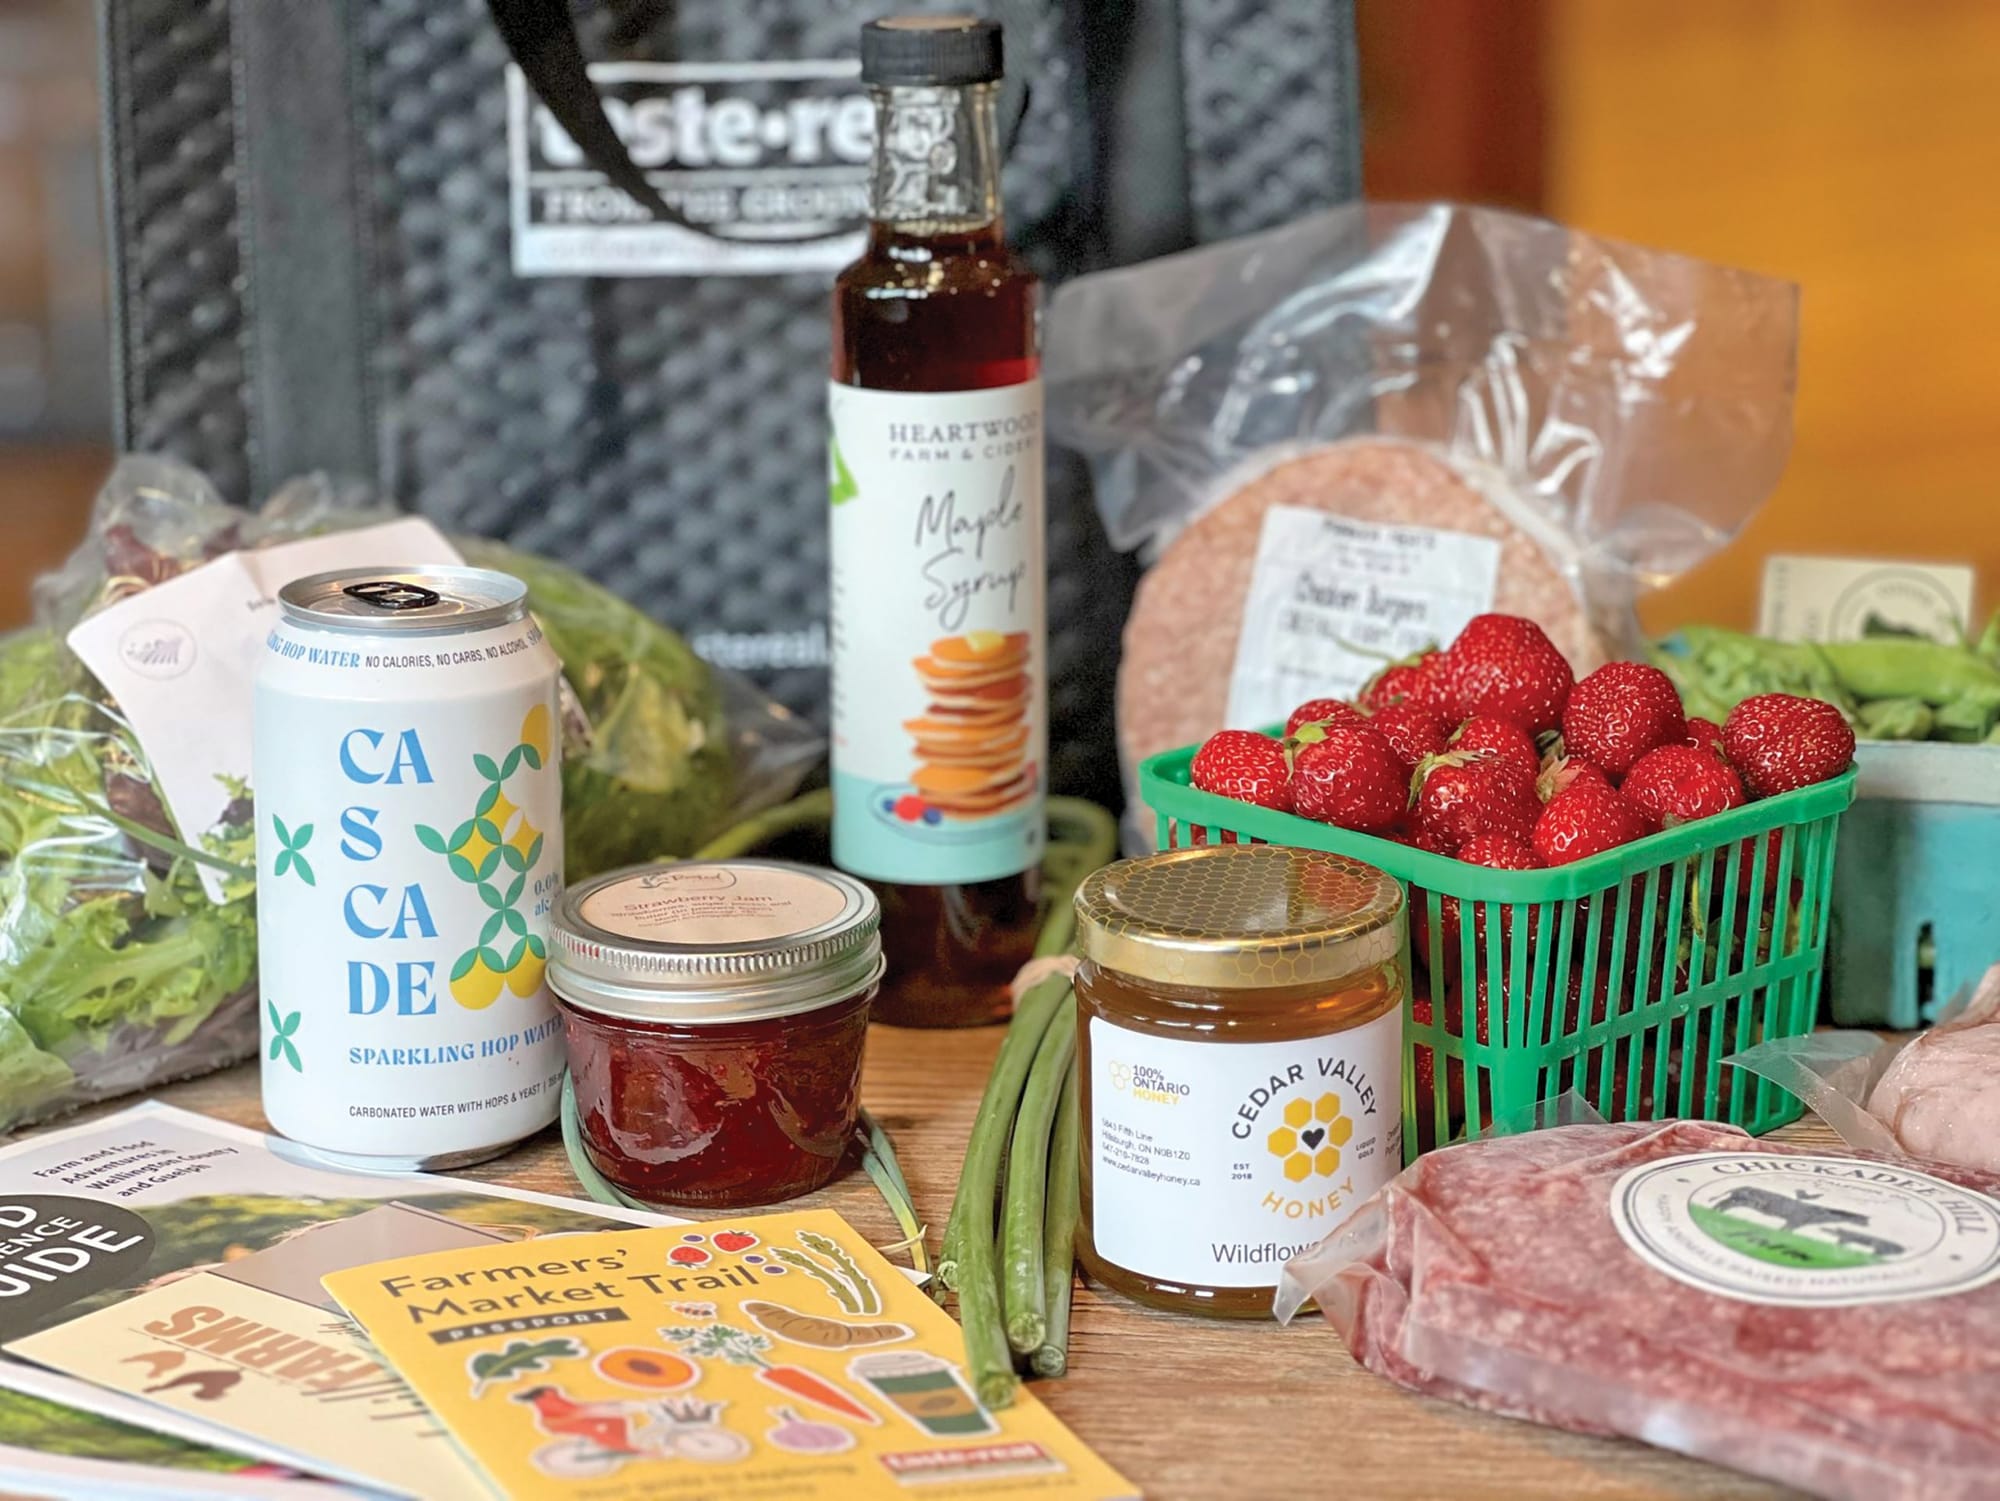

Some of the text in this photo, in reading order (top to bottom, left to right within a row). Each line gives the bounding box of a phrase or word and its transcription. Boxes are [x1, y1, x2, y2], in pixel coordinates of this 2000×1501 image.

[914, 464, 1023, 561] Maple
[921, 547, 1027, 633] Syrup
[282, 640, 306, 660] HOP
[307, 648, 361, 669] WATER
[365, 655, 380, 669] NO
[383, 653, 435, 669] CALORIES,
[436, 652, 451, 667] NO
[452, 649, 486, 666] CARBS,
[486, 646, 499, 659] NO
[498, 640, 529, 658] ALCOHOL
[338, 727, 435, 785] CA
[340, 805, 383, 862] S
[343, 882, 440, 940] CA
[624, 894, 726, 911] Strawberry
[733, 894, 774, 903] Jam
[346, 960, 438, 1017] DE
[349, 1042, 475, 1066] SPARKLING
[481, 1033, 519, 1057] HOP
[1132, 1064, 1165, 1081] 100%
[1132, 1076, 1191, 1096] ONTARIO
[349, 1105, 416, 1118] CARBONATED
[420, 1104, 455, 1118] WATER
[457, 1097, 483, 1114] WITH
[485, 1093, 509, 1110] HOPS
[511, 1092, 518, 1104] &
[519, 1082, 541, 1100] YEAST
[1132, 1087, 1180, 1105] HONEY
[1232, 1063, 1305, 1140] CEDAR
[1317, 1057, 1377, 1117] VALLEY
[1135, 1130, 1153, 1142] Line
[1138, 1143, 1152, 1154] ON
[33, 1159, 82, 1178] Farm
[80, 1149, 113, 1163] and
[61, 1151, 156, 1184] Adventures
[85, 1146, 240, 1191] Wellington County
[117, 1163, 212, 1198] and Guelph
[1102, 1155, 1201, 1187] www.cedarvalleyhoney.ca
[1231, 1173, 1253, 1181] 2018
[1233, 1163, 1250, 1171] EST
[1262, 1176, 1355, 1220] HONEY
[1711, 1161, 1946, 1198] CHICKADEE
[1939, 1198, 1989, 1236] HILL
[0, 1216, 84, 1260] ENCE
[1211, 1240, 1320, 1265] Wildflow
[406, 1264, 760, 1324] Market Trail
[448, 1311, 610, 1341] PASSPORT
[143, 1305, 382, 1393] FARMS
